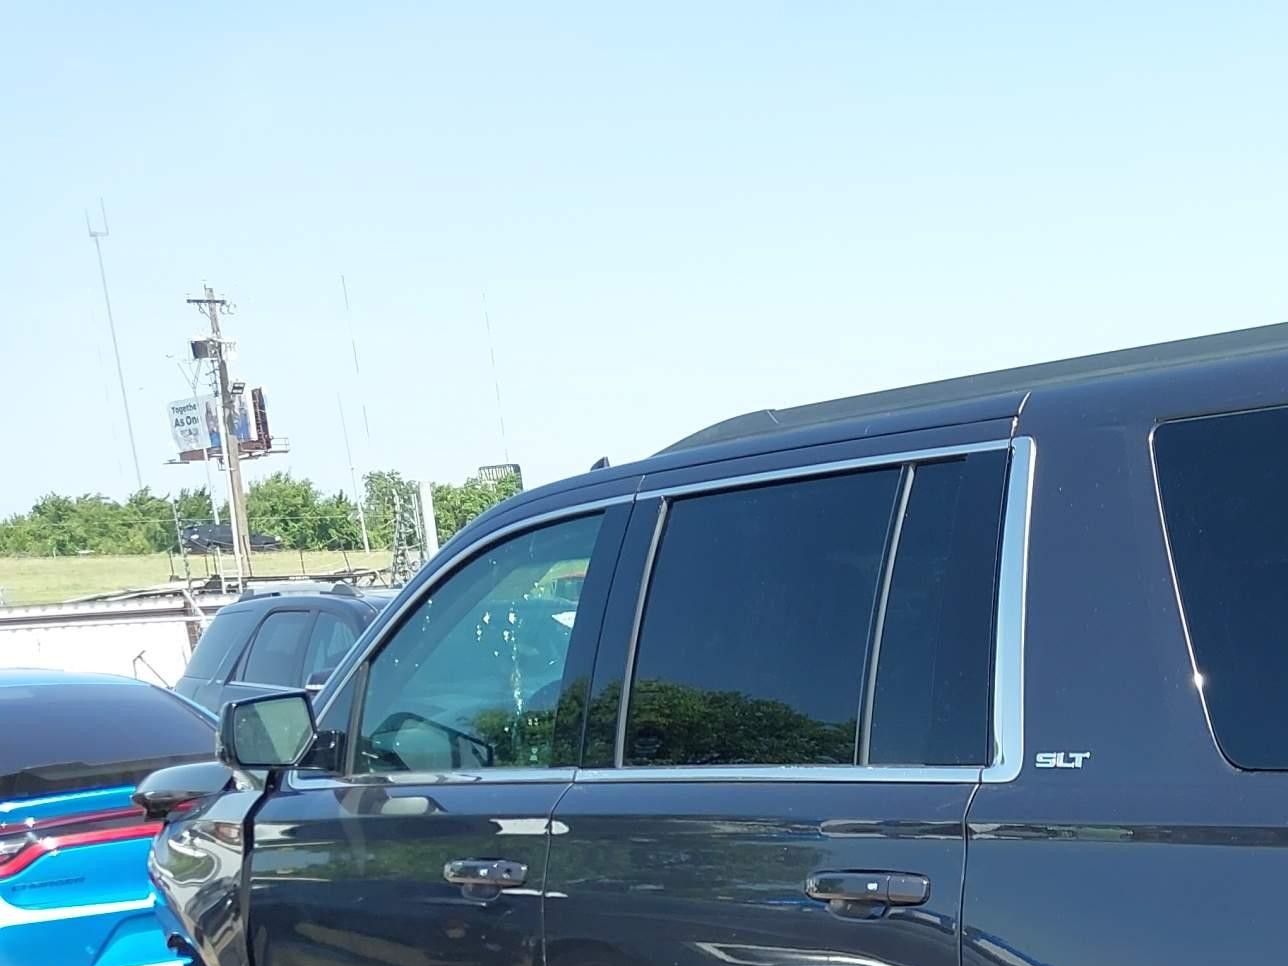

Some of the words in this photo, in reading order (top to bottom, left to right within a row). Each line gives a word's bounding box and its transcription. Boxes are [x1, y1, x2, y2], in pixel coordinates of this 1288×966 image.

[171, 403, 198, 415] Togethe
[174, 417, 186, 429] As
[1035, 751, 1091, 769] SLT
